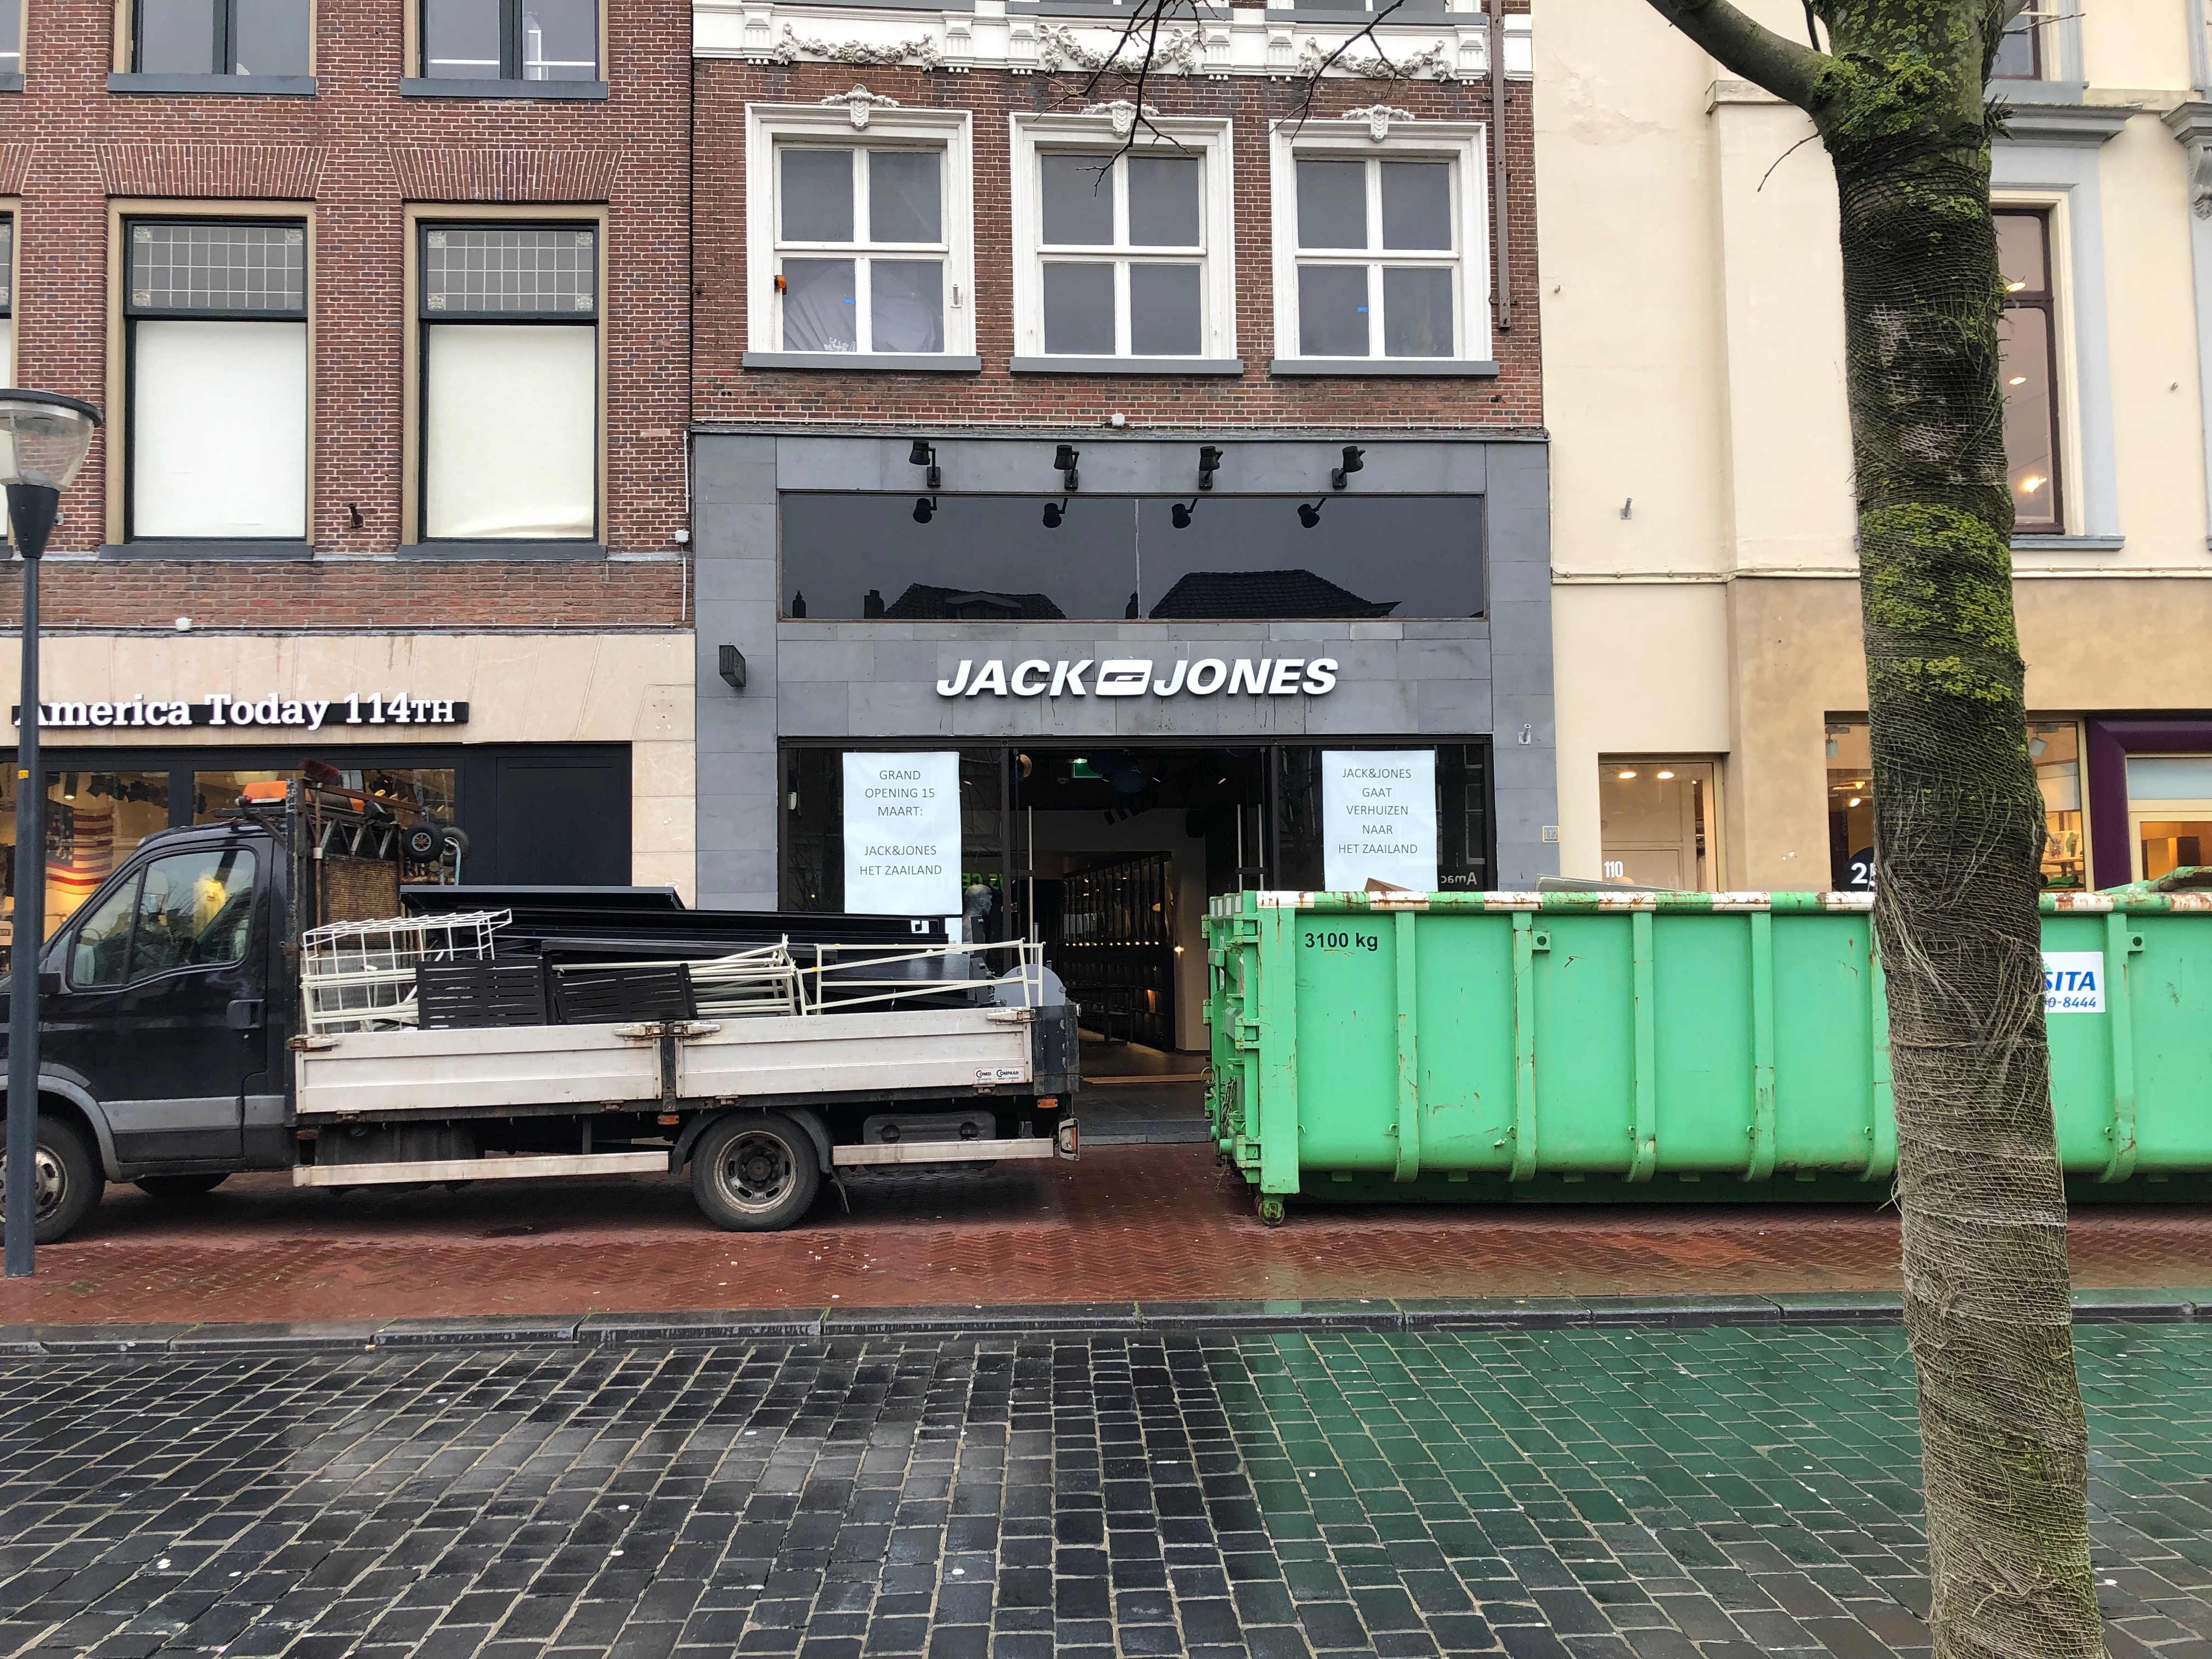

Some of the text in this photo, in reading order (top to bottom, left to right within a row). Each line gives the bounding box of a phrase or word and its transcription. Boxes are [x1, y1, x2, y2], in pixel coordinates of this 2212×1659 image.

[936, 658, 1339, 696] JACK JONES
[205, 693, 330, 731] Today
[344, 692, 455, 723] 114TH
[879, 770, 921, 780] GRAND
[1342, 768, 1412, 778] JACK&JONES
[865, 788, 935, 798] OPENING 15
[1362, 788, 1392, 798] GAAT
[877, 806, 923, 816] MAART:
[1346, 805, 1408, 815] VERHUIZEN
[1362, 825, 1393, 834] NAAR
[1544, 829, 1558, 839] 112
[864, 845, 937, 856] JACK&JONES
[1339, 844, 1418, 854] HET ZAAILAND
[860, 865, 942, 876] HET ZAAILAND
[1604, 861, 1624, 878] 110
[1305, 933, 1378, 951] 3100 kg
